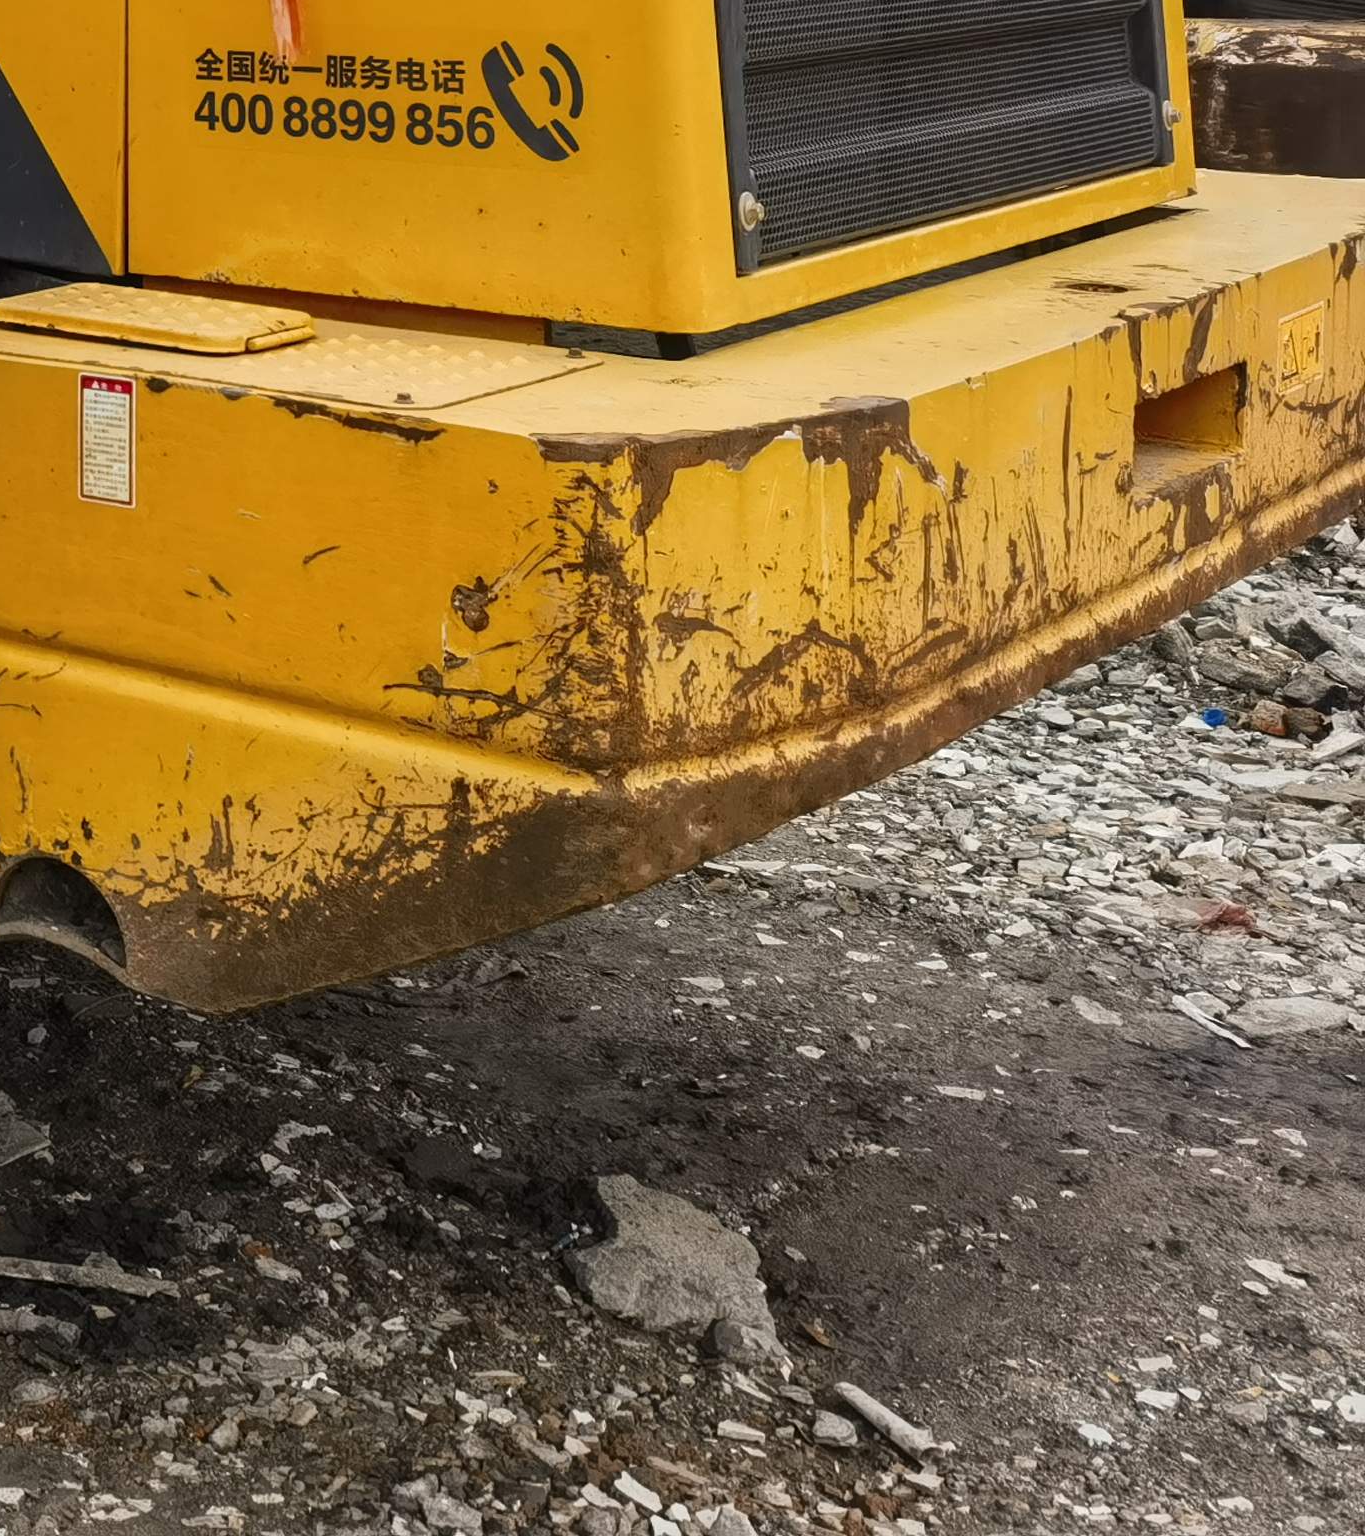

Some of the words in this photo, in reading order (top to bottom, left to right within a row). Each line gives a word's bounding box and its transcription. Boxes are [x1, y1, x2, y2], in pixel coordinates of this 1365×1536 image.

[194, 47, 466, 95] 全国统一服务电话
[194, 91, 274, 136] 400
[282, 95, 396, 144] 8899
[405, 102, 496, 150] 856
